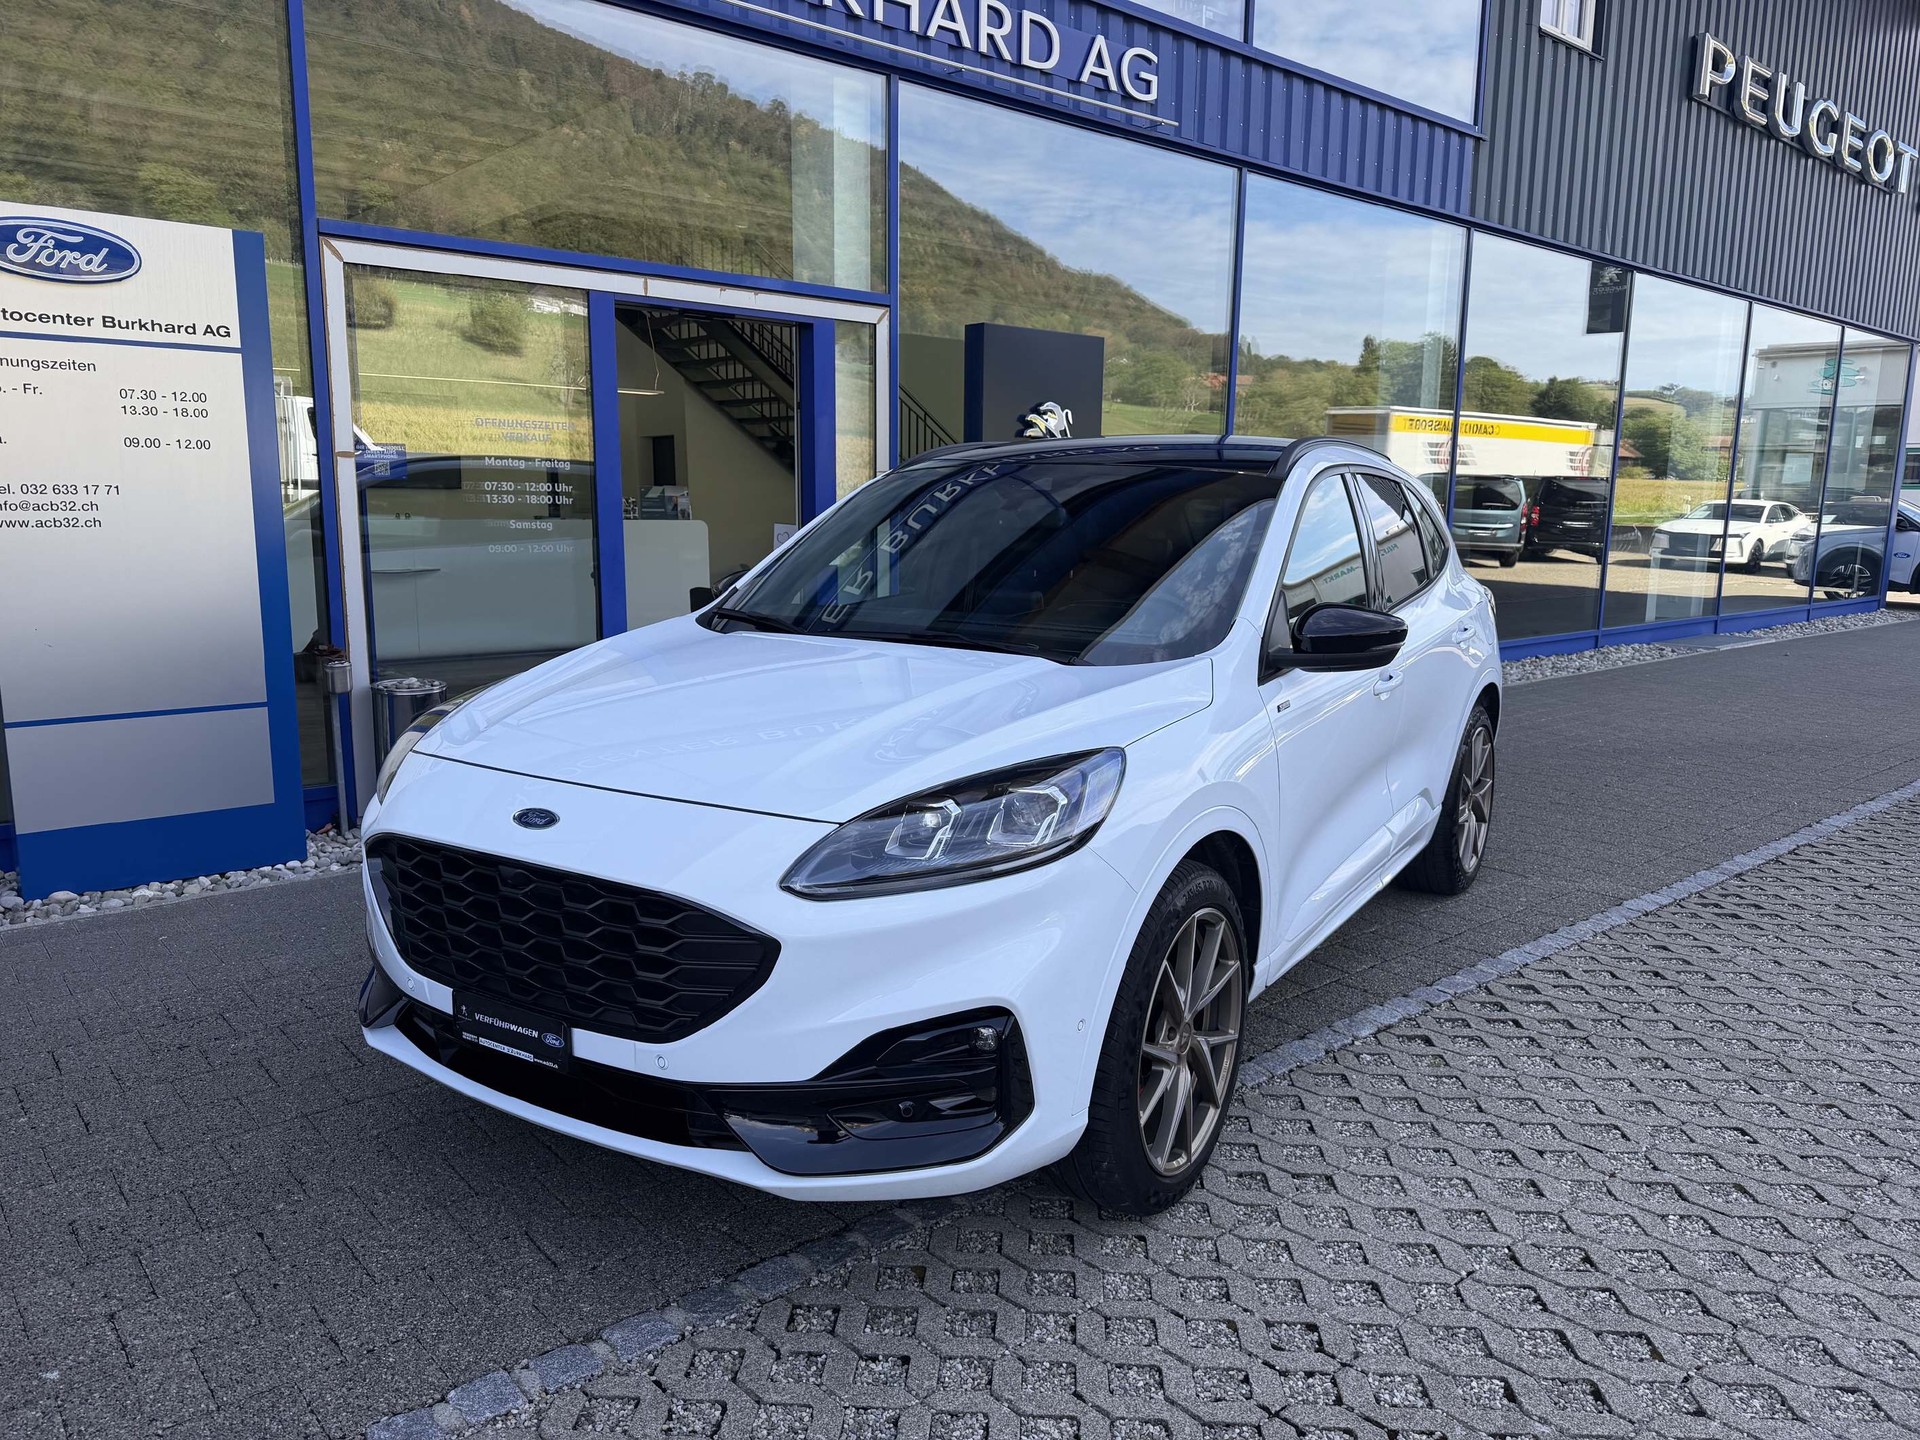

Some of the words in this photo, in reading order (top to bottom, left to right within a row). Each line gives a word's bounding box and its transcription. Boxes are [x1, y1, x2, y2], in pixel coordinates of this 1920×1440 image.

[1079, 33, 1160, 102] AG
[1694, 31, 1919, 194] PEUGEOT
[5, 226, 110, 273] Ford
[0, 308, 95, 327] tocenter
[101, 315, 197, 336] Burkhard
[202, 324, 232, 339] AG
[23, 382, 43, 395] Fr.
[119, 388, 157, 401] 07.30
[171, 391, 208, 403] 12.00
[121, 405, 158, 417] 13.30
[172, 407, 209, 419] 18.00
[123, 437, 161, 449] 09.00
[175, 439, 211, 451] 12.00
[484, 456, 526, 469] Montag
[534, 458, 571, 470] Freitag
[20, 483, 48, 495] 032
[52, 484, 79, 495] 633
[83, 484, 100, 495] 17
[104, 484, 120, 495] 71
[484, 481, 515, 491] 07:30
[524, 482, 552, 492] 12:00
[554, 483, 573, 493] Uhr
[485, 494, 515, 504] 13:30
[525, 494, 553, 504] 18:00
[555, 495, 574, 505] Uhr
[509, 519, 553, 531] Samstag
[488, 544, 517, 553] 09:00
[528, 544, 554, 553] 12:00
[556, 544, 574, 553] Uhr
[474, 1012, 539, 1039] VERFÜHRWAGEN
[545, 1034, 561, 1046] Ford
